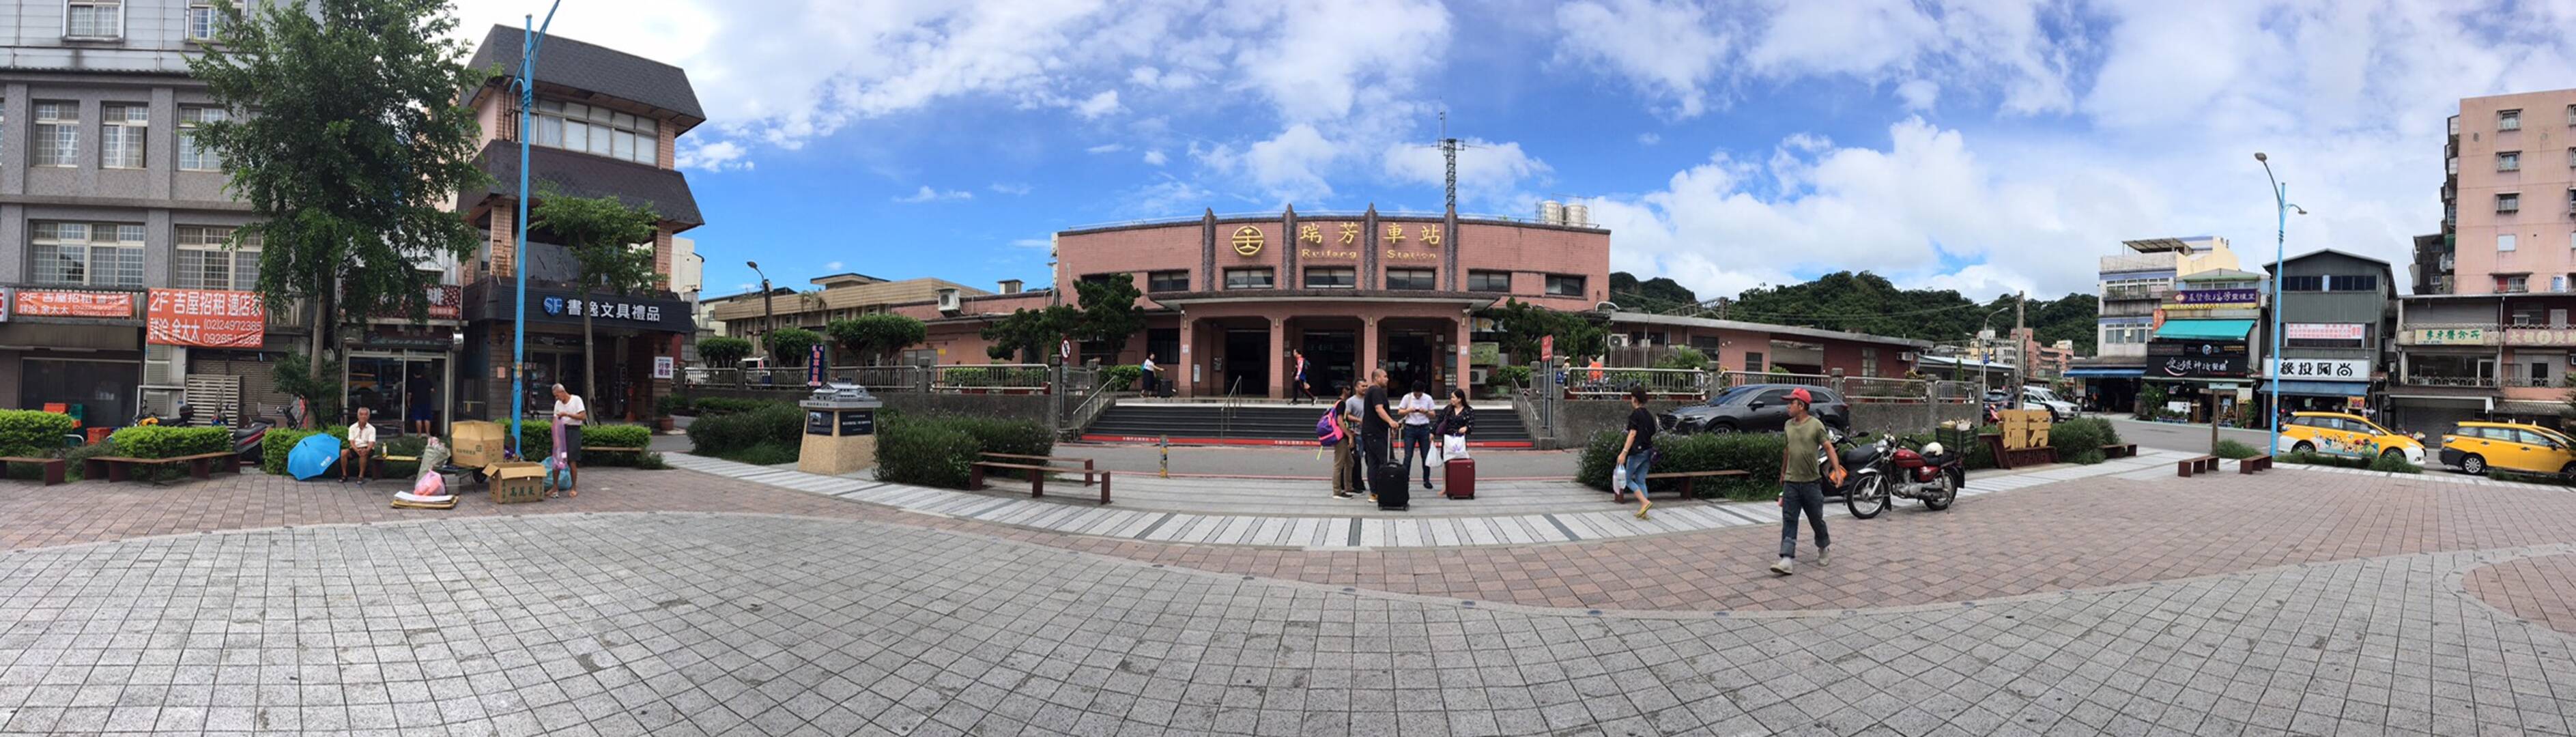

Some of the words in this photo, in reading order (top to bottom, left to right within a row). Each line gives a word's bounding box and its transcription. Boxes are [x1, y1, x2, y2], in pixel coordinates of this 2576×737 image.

[1300, 222, 1358, 244] 瑞芳
[1384, 222, 1440, 244] 車站
[1302, 248, 1358, 259] Ruifang
[1386, 249, 1436, 259] Station
[19, 293, 38, 301] 2F
[42, 293, 93, 303] 吉屋招租
[149, 291, 170, 312] 2F
[173, 292, 225, 315] 吉屋招租
[228, 293, 263, 317] 適店家
[172, 319, 200, 341] 余太太
[203, 319, 262, 331] (02)24972385
[2001, 409, 2051, 450] 瑞芳
